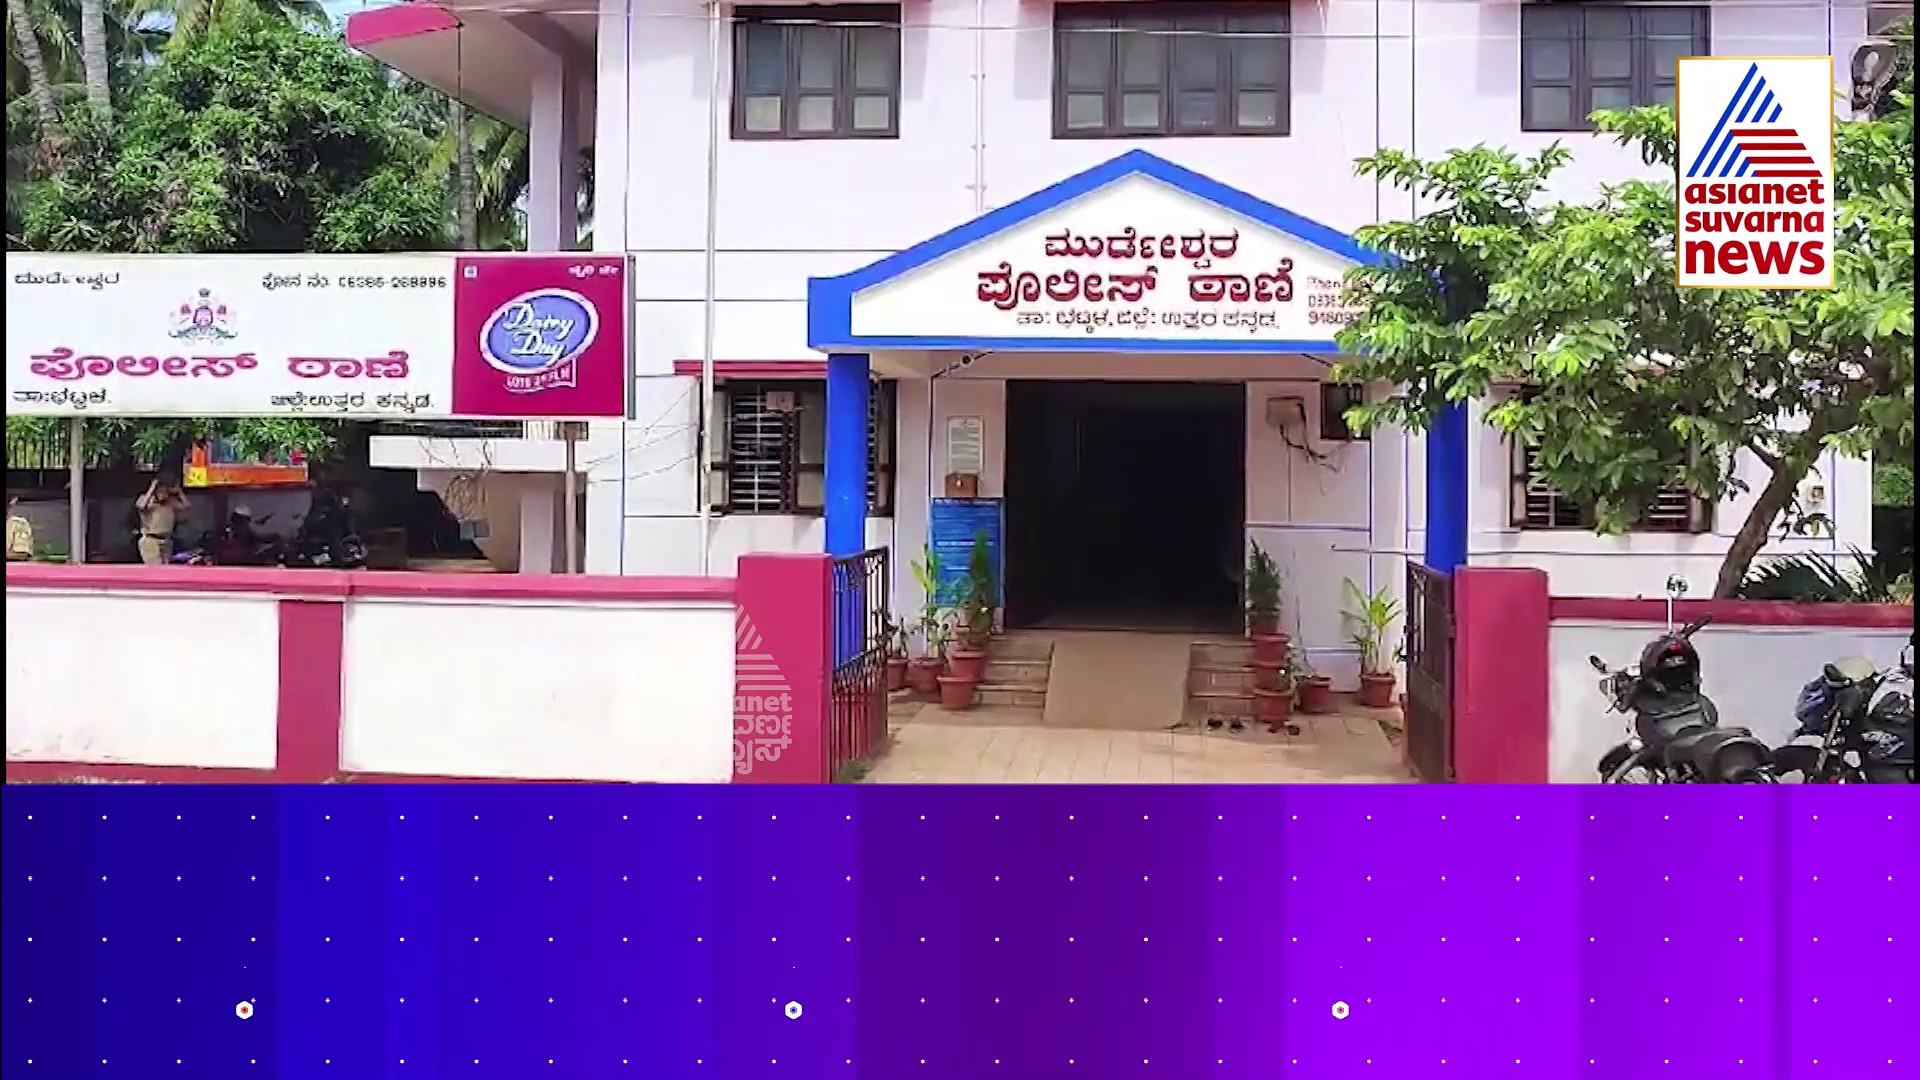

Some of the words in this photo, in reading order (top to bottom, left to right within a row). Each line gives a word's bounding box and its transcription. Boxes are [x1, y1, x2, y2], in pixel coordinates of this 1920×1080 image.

[977, 260, 1158, 312] ಪೊಲೀಸ್
[1186, 257, 1294, 304] ಠಾಣೆ
[29, 346, 259, 382] ಪೊಲೀಸ್
[287, 350, 410, 379] ಠಾಣೆ
